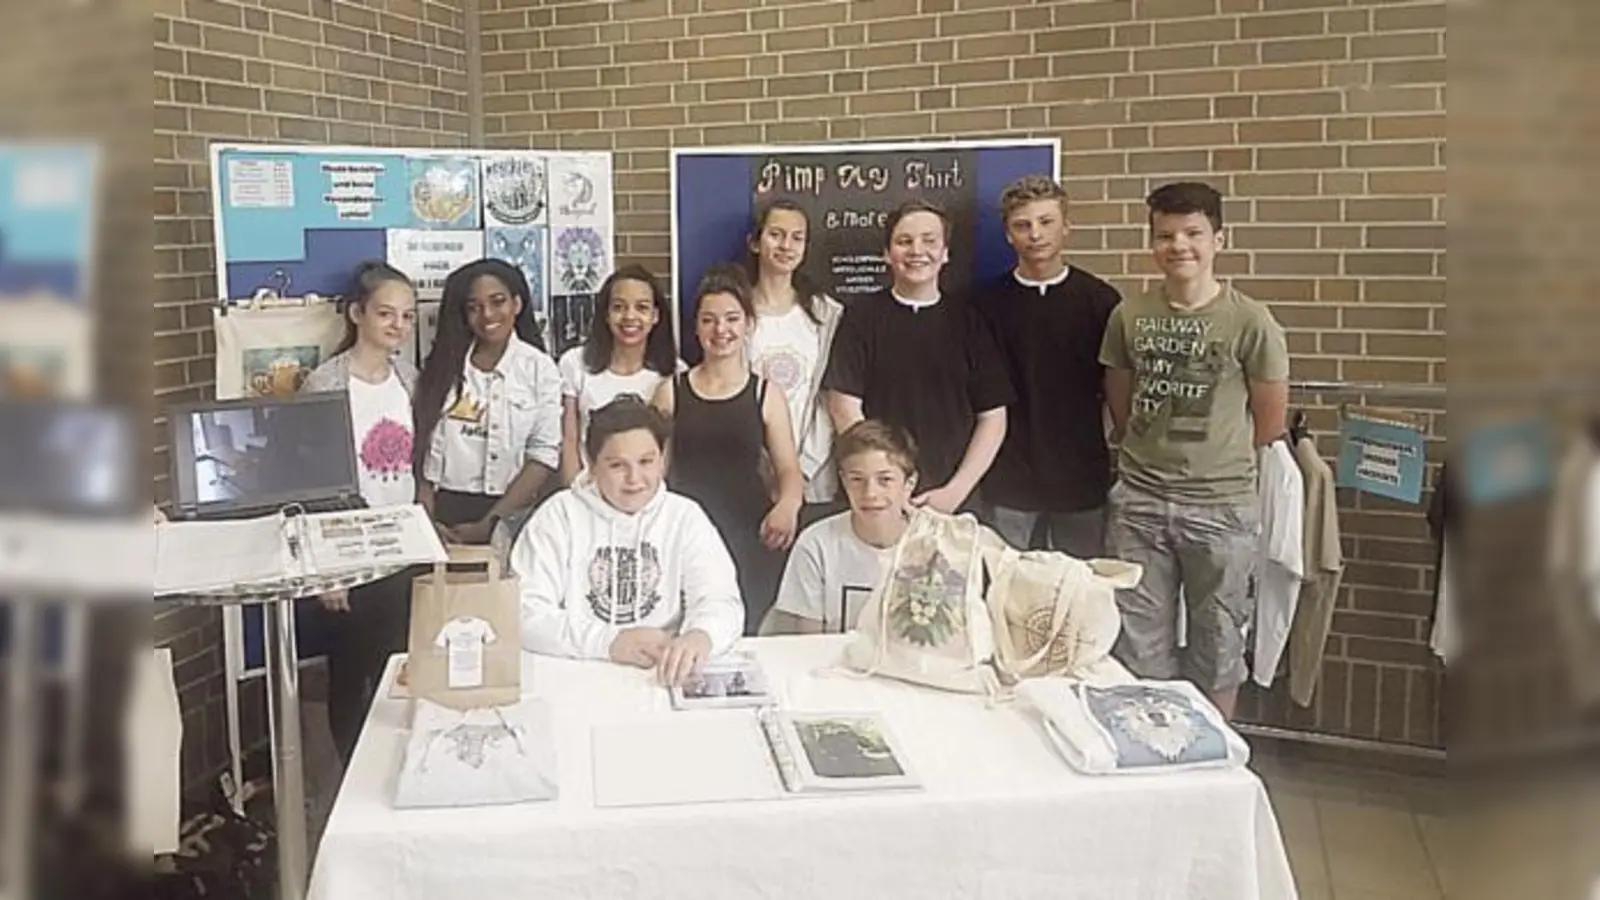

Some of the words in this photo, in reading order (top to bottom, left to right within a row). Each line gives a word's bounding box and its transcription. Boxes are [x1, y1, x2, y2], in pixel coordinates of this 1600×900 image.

[757, 159, 827, 195] Pimp
[1136, 317, 1214, 337] RAILWAY
[1134, 336, 1207, 357] GARDEN
[1140, 377, 1210, 399] VORITE
